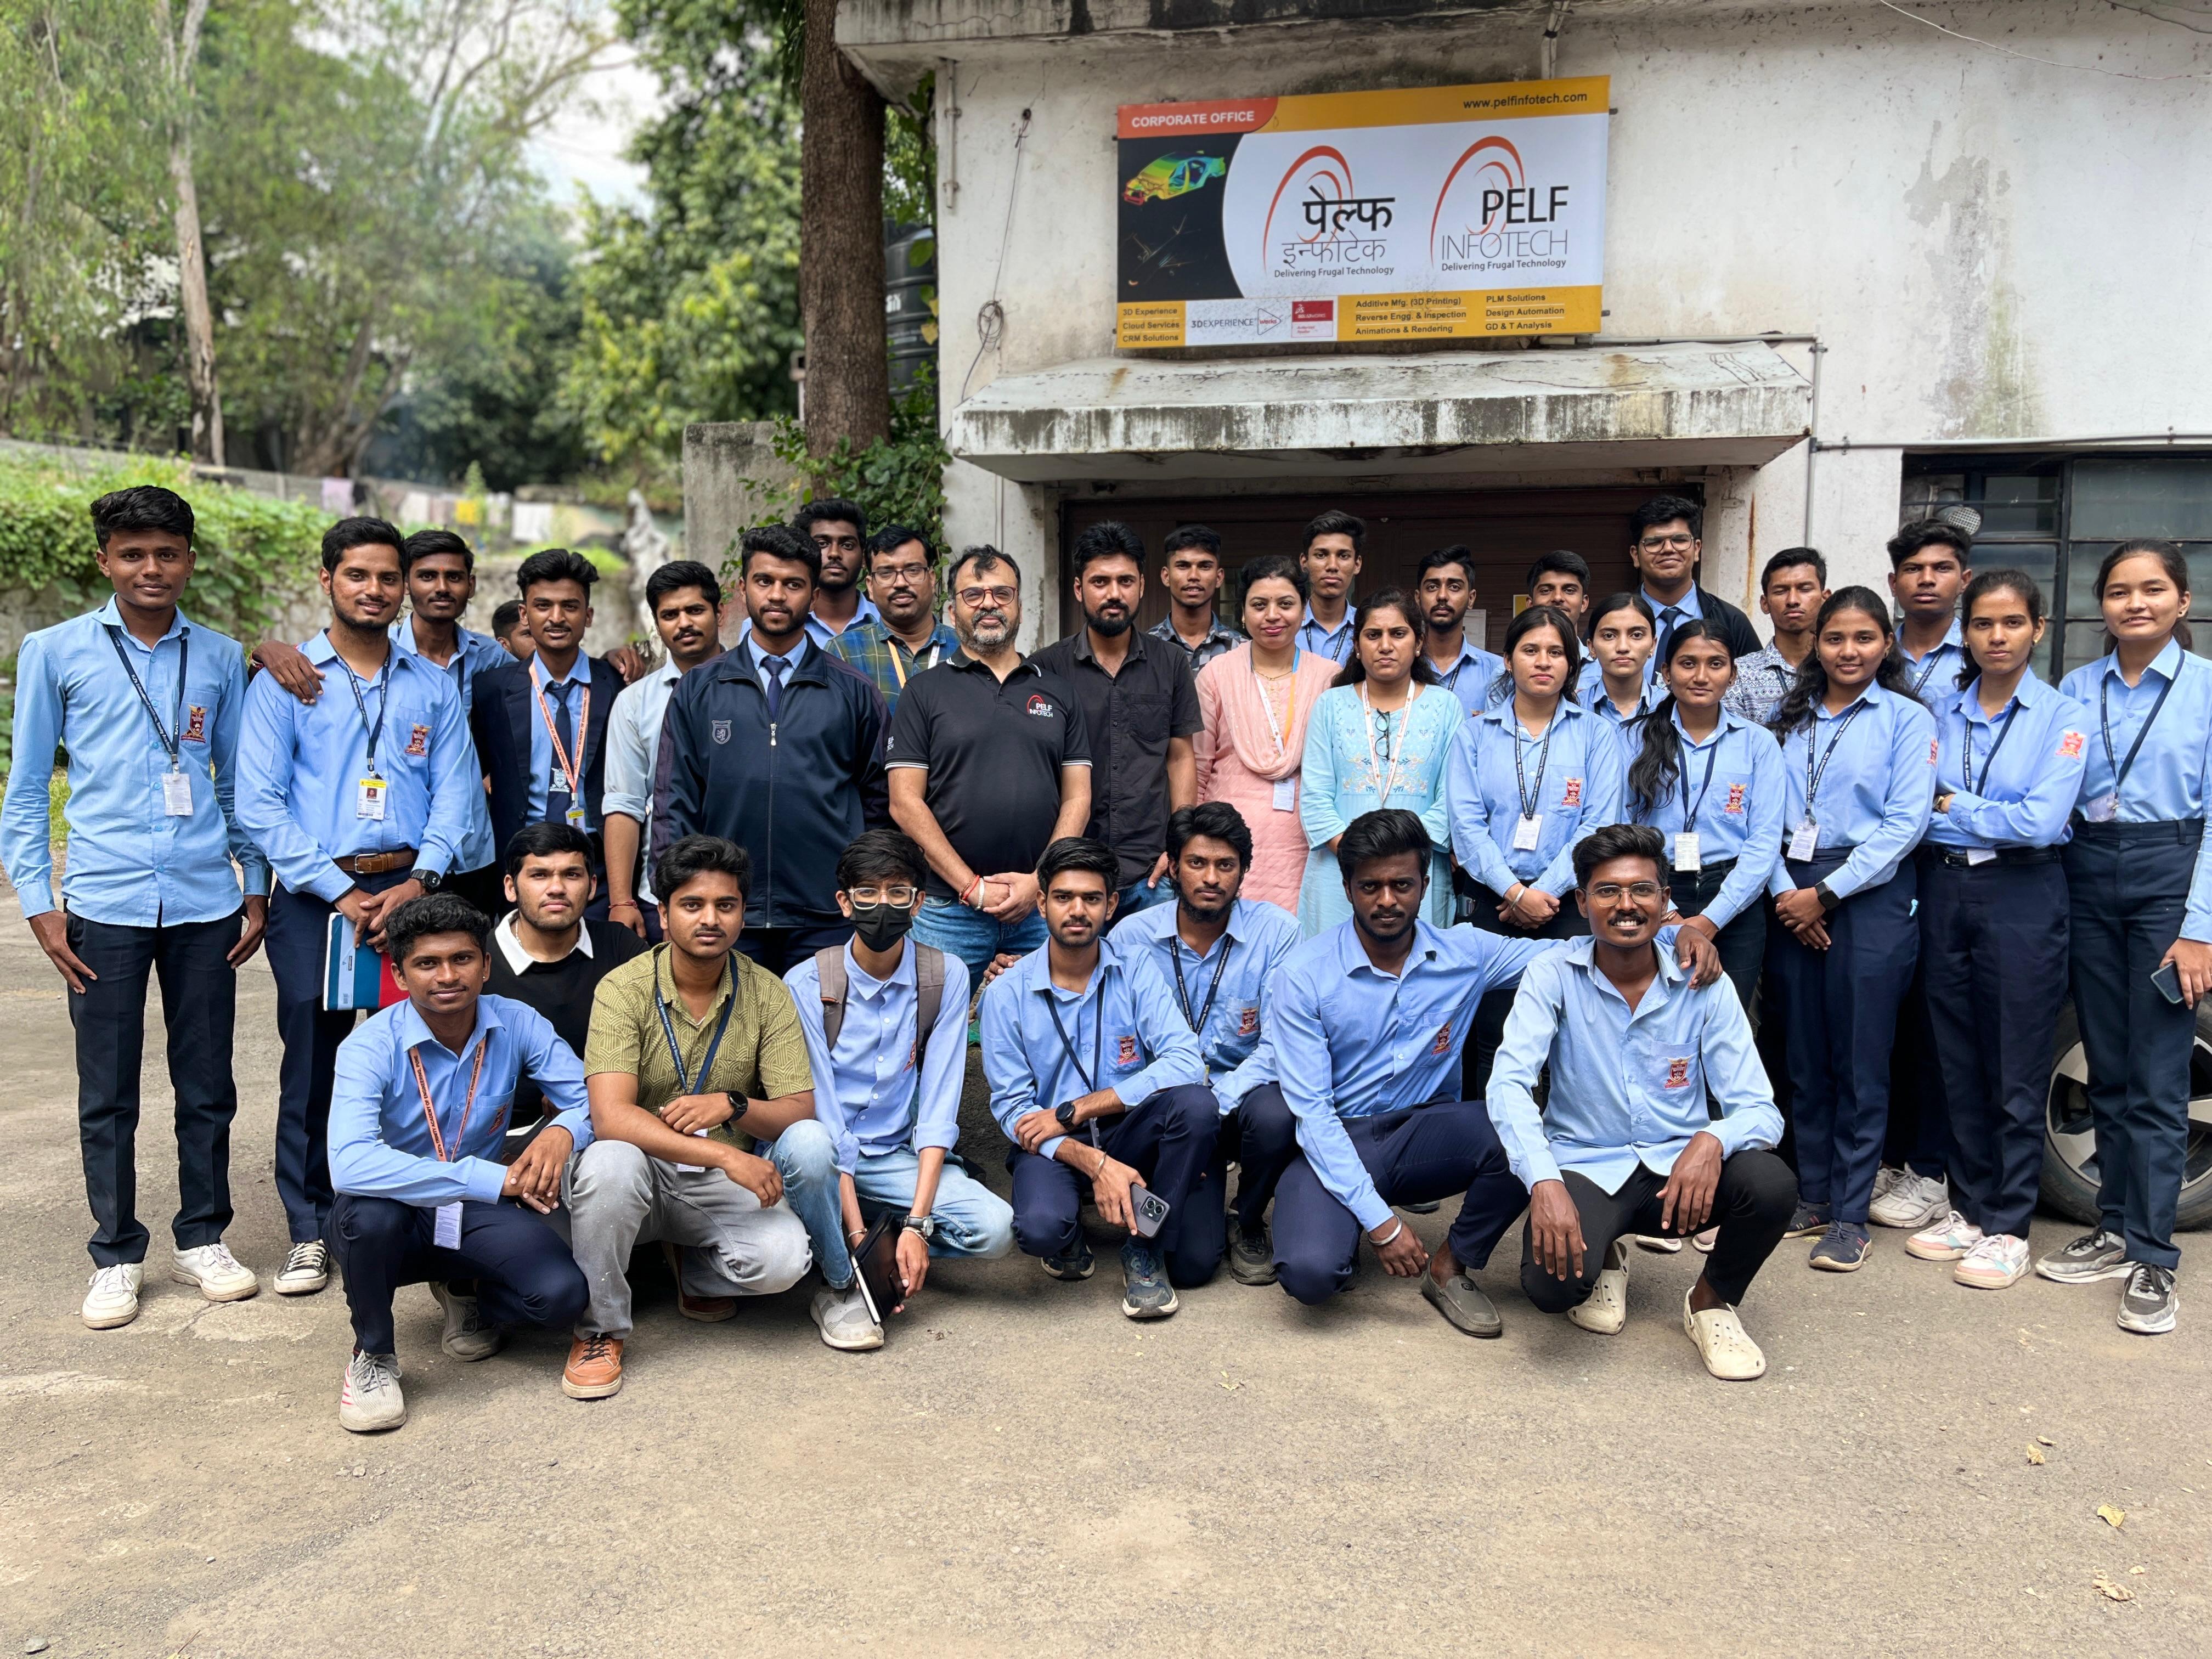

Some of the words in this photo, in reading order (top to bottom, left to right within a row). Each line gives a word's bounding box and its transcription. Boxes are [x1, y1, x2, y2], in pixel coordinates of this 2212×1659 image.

[1463, 93, 1587, 109] www.pelfinfotech.com
[1132, 114, 1207, 128] CORPORATE
[1210, 111, 1255, 123] OFFICE
[1302, 185, 1396, 233] पेल्फ
[1482, 185, 1569, 225] PELF
[1442, 229, 1567, 260] INFOTECH
[1442, 263, 1485, 271] Delivering
[1487, 260, 1514, 269] Frugal
[1516, 258, 1566, 268] Technology
[1274, 269, 1316, 278] Delivering
[1318, 268, 1344, 277] Frugal
[1346, 266, 1394, 274] Technology
[1410, 298, 1424, 307] (3D
[1426, 297, 1461, 306] Printing)
[1135, 308, 1177, 316] Experience
[1390, 313, 1413, 321] Engg.
[1412, 325, 1453, 334] Rendering
[1516, 321, 1552, 330] Analysis
[1036, 703, 1053, 711] PELF
[1029, 709, 1053, 718] INFOTECH
[426, 1106, 435, 1127] ACADEMY
